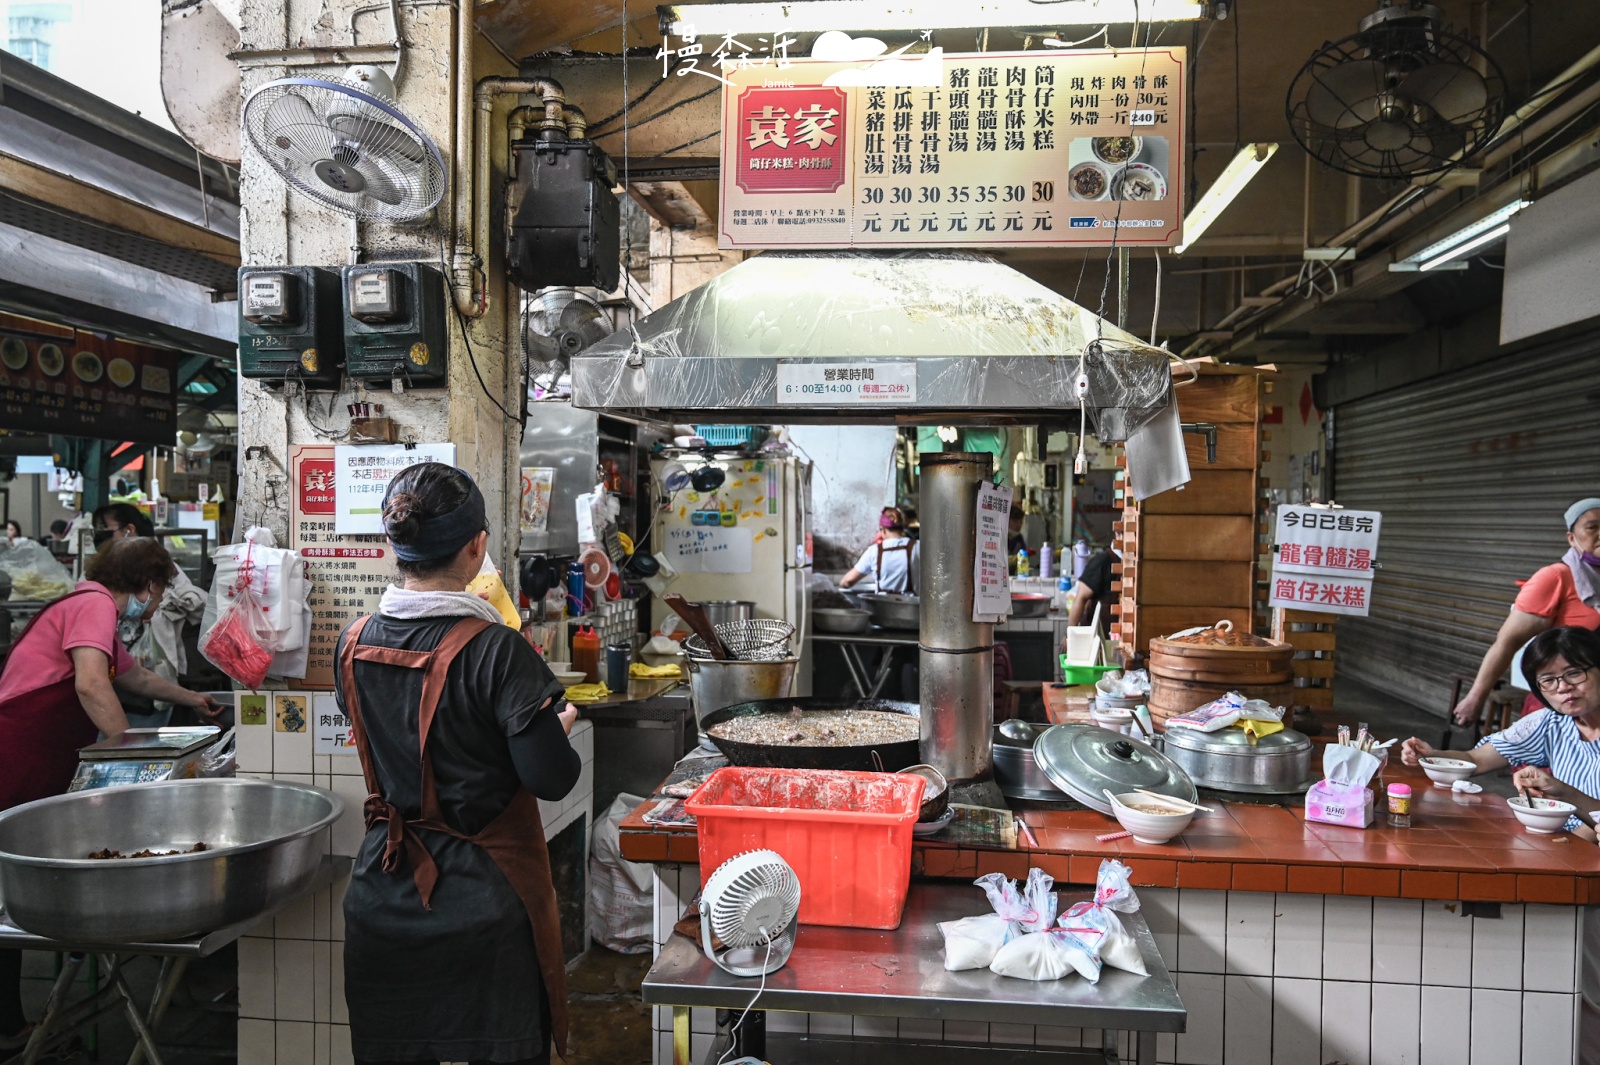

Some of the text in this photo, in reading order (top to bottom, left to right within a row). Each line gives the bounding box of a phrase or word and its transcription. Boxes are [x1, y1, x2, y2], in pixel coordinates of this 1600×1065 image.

[1070, 75, 1168, 91] 現炸肉骨酥
[745, 103, 840, 151] 袁家
[865, 86, 886, 174] 菜豬肚湯
[892, 86, 914, 174] 瓜排骨湯
[920, 86, 942, 174] 干排骨湯
[948, 67, 970, 152] 豬頭髓湯
[976, 66, 998, 152] 龍骨髓湯
[1004, 66, 1027, 151] 肉骨酥湯
[1032, 65, 1055, 150] 筒仔米糕
[861, 187, 884, 233] 30 元
[889, 187, 912, 233] 30 元
[918, 187, 941, 233] 30 元
[947, 186, 970, 232] 35 元
[975, 186, 998, 232] 35 元
[1002, 185, 1025, 232] 30 元
[1032, 181, 1055, 231] 30 元
[824, 368, 874, 381] 營業時間
[1283, 511, 1374, 533] 今日已售完
[1280, 542, 1371, 570] 龍骨髓湯
[1275, 578, 1365, 606] 筒仔米糕
[310, 648, 334, 656] 即成美
